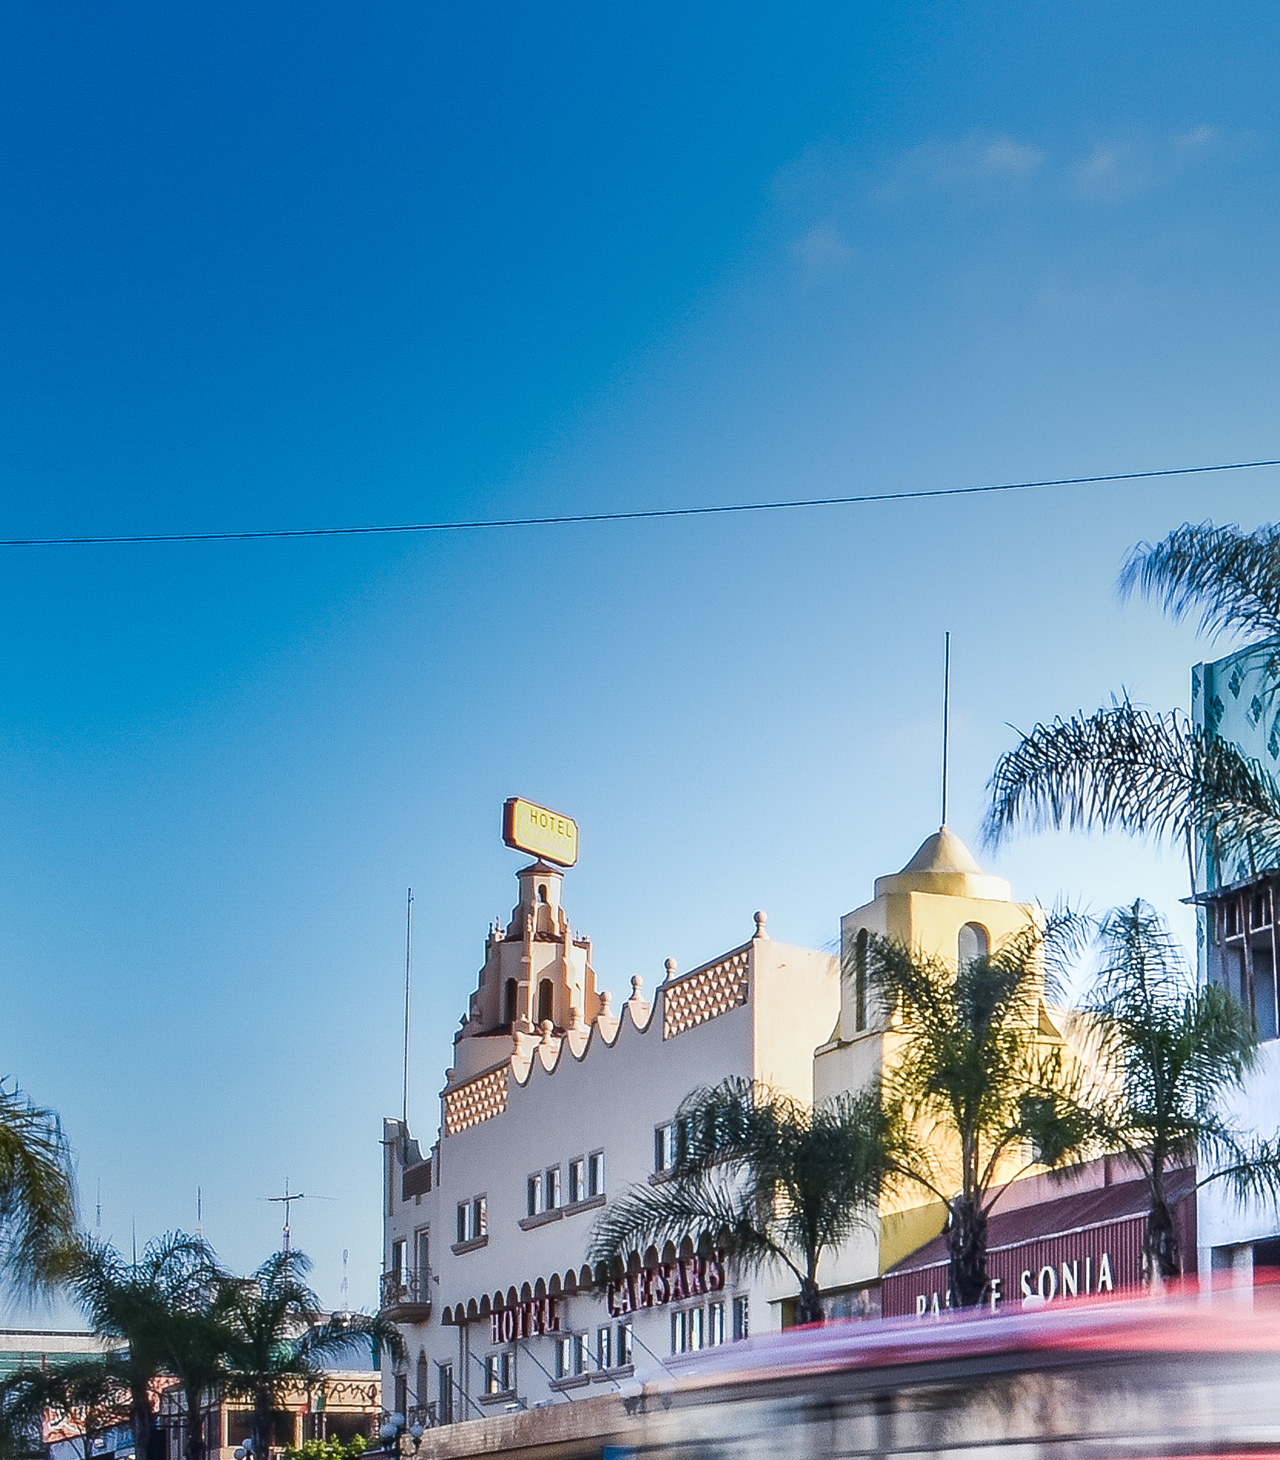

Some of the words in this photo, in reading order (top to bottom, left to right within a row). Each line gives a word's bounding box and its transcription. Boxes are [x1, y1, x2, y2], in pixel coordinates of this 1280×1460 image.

[529, 809, 572, 838] HOTEL
[1020, 1252, 1114, 1308] SONIA
[490, 1298, 561, 1345] HOTEL
